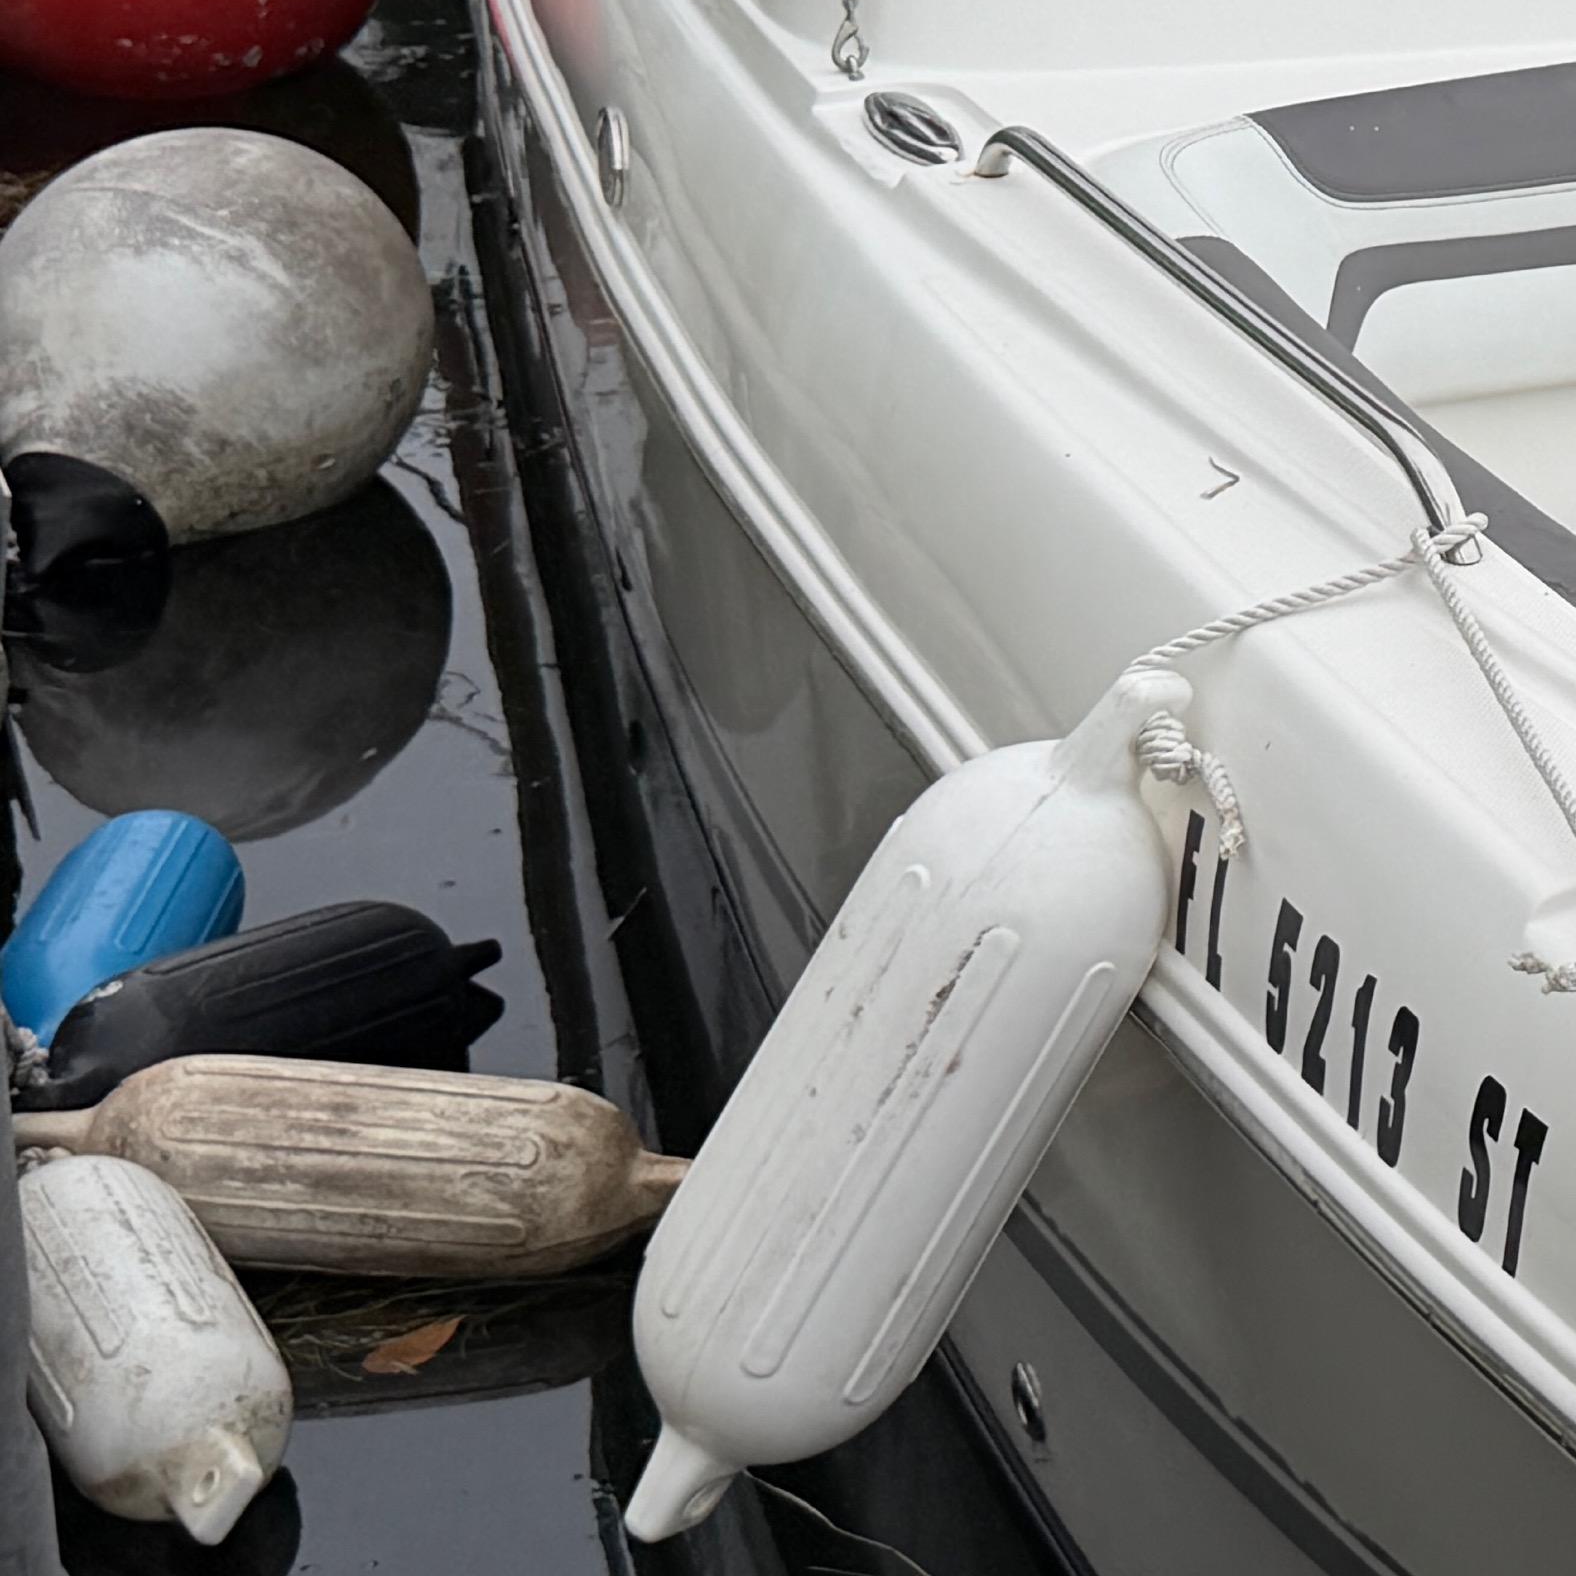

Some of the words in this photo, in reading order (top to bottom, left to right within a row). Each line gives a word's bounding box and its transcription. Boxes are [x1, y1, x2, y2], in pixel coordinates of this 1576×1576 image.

[1175, 809, 1229, 992] FL
[1265, 897, 1420, 1168] 5213
[1457, 1075, 1549, 1279] ST
